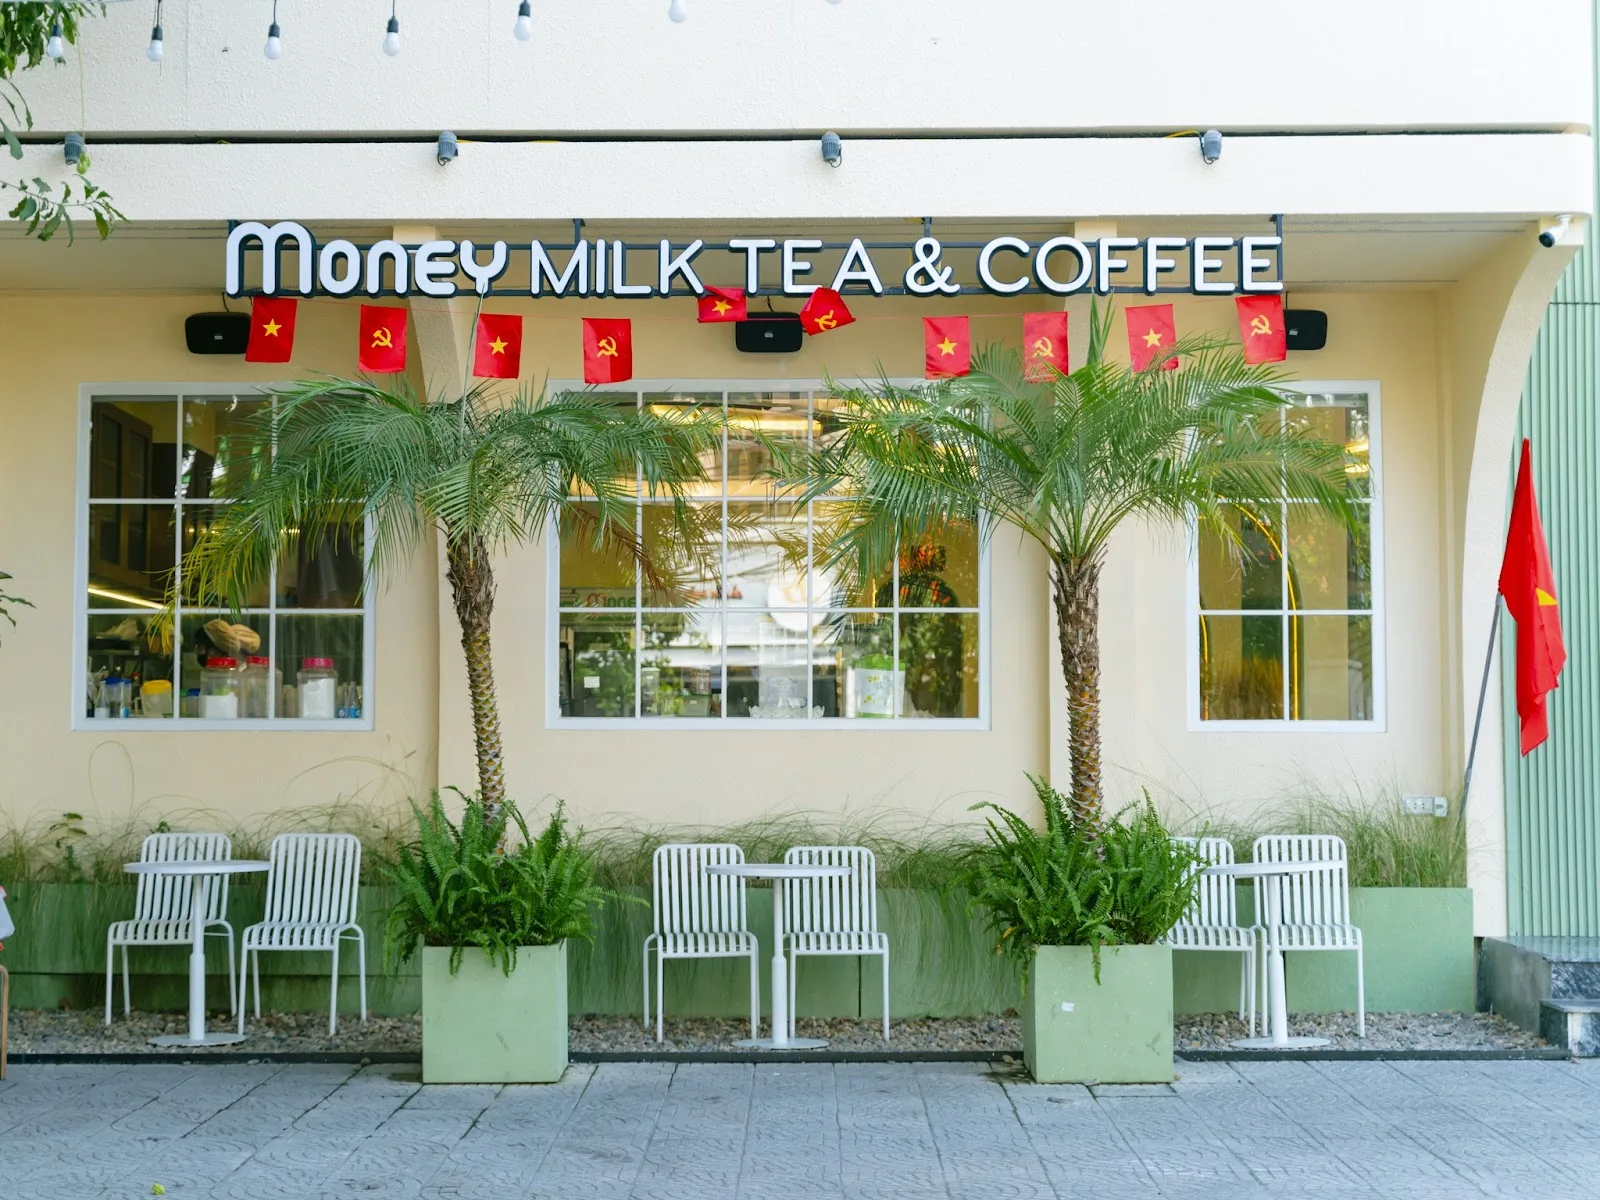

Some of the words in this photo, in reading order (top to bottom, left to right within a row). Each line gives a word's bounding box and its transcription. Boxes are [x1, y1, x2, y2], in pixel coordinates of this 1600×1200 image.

[530, 238, 705, 295] MILK
[728, 237, 883, 295] TEA
[904, 236, 961, 294] &
[977, 235, 1284, 295] COFFEE
